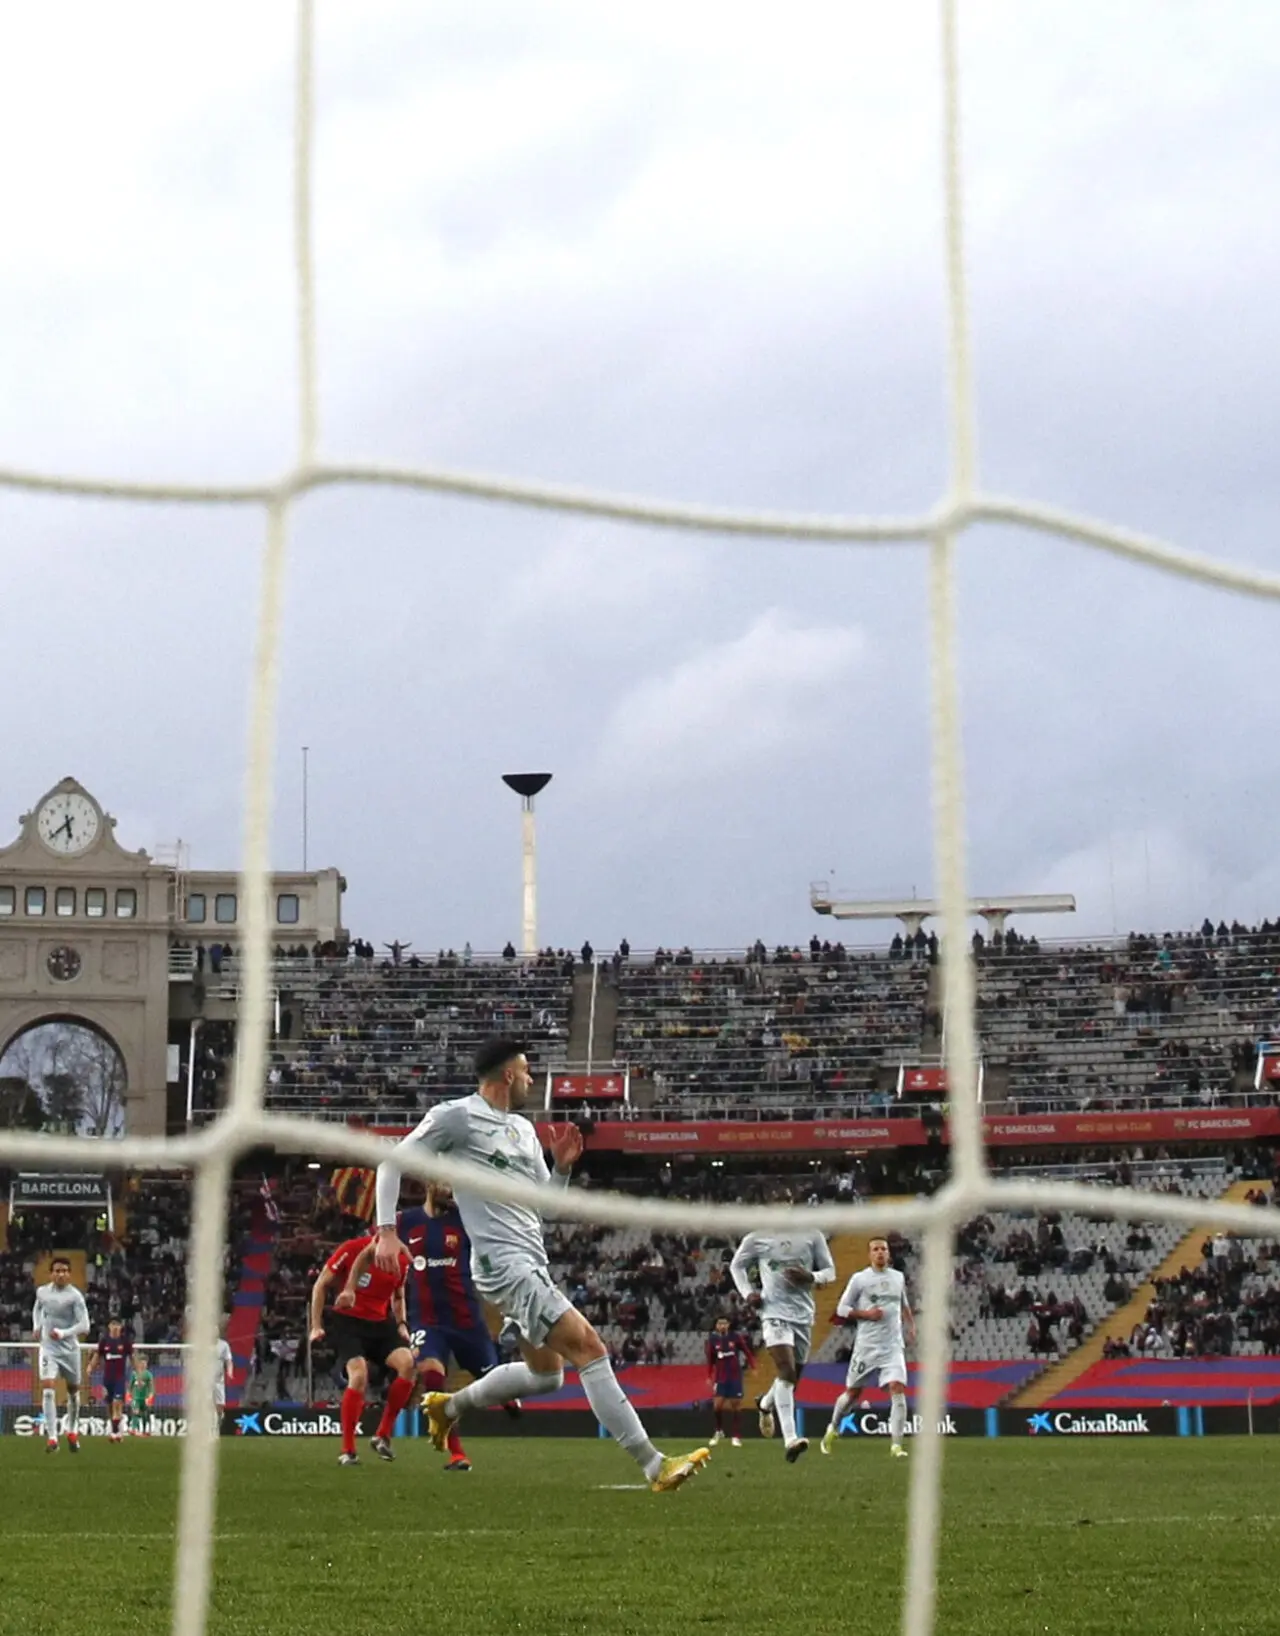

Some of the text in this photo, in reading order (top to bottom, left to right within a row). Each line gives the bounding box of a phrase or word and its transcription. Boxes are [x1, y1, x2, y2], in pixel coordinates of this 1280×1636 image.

[21, 1182, 101, 1194] BARCELONA
[264, 1412, 364, 1435] CaixaBak
[860, 1413, 958, 1434] CaiaBnk
[1054, 1411, 1150, 1433] CaixaBank
